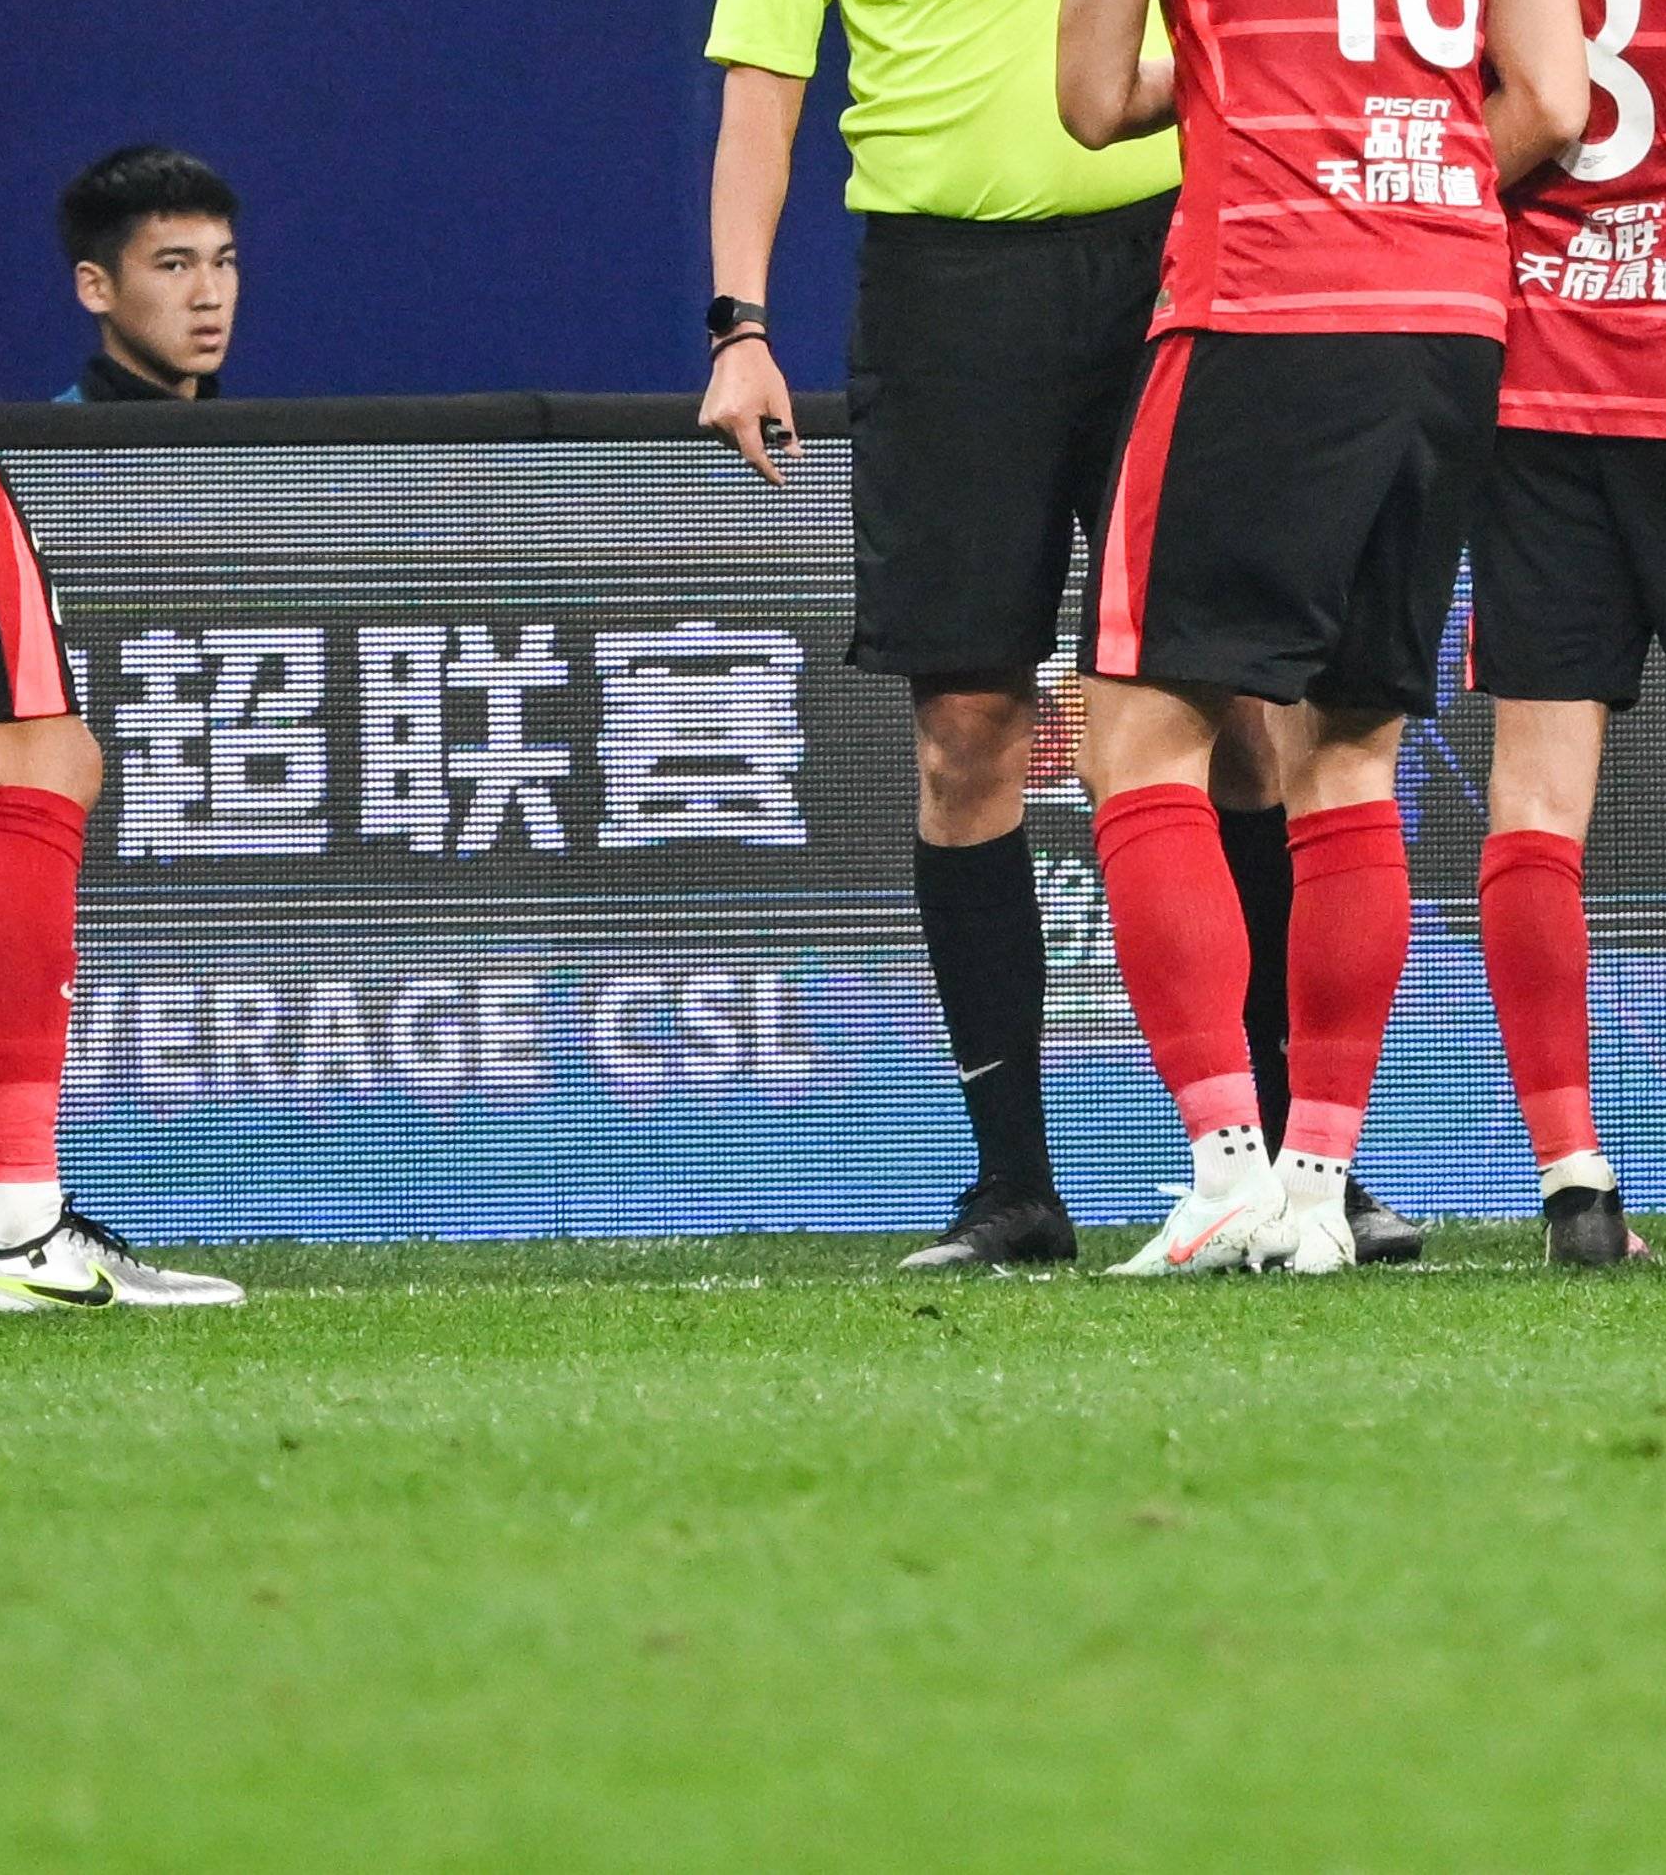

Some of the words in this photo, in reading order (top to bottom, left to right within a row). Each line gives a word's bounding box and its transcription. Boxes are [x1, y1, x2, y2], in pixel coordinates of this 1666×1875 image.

[1363, 96, 1449, 119] PISEN
[1363, 118, 1447, 162] 品胜
[1316, 160, 1483, 207] 天府绿道
[1588, 202, 1663, 225] SEN
[1567, 220, 1662, 262] 品胜
[588, 970, 820, 1087] CSL
